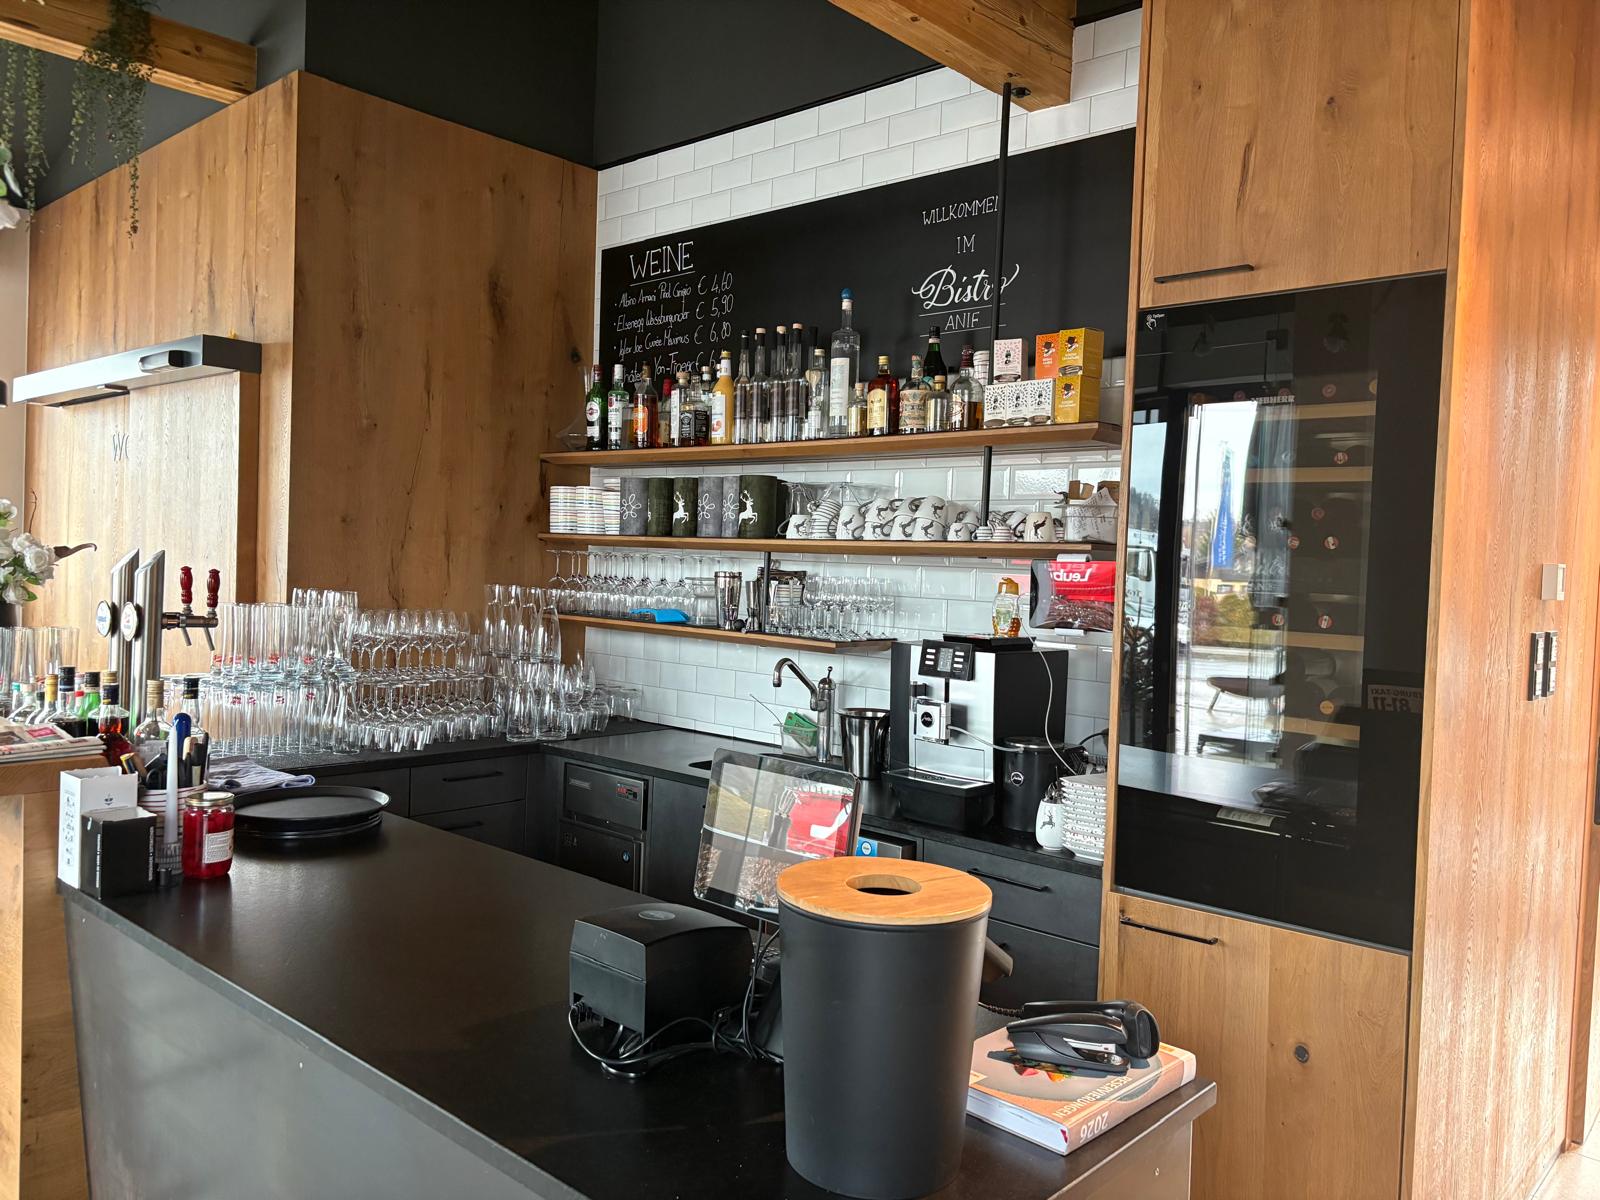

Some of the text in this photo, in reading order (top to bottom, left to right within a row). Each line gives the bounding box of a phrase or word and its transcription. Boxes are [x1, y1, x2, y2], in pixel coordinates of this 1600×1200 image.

[956, 233, 976, 254] IM
[629, 241, 694, 280] WEINE
[697, 275, 708, 295] €
[710, 270, 733, 294] 4,60
[695, 301, 705, 320] €
[710, 293, 734, 318] 5,90
[693, 325, 704, 345] €
[709, 321, 732, 343] 6,80
[944, 311, 980, 331] ANIF
[1051, 1075, 1133, 1119] RESERVIERUNGEN
[1079, 1110, 1110, 1144] 2026
